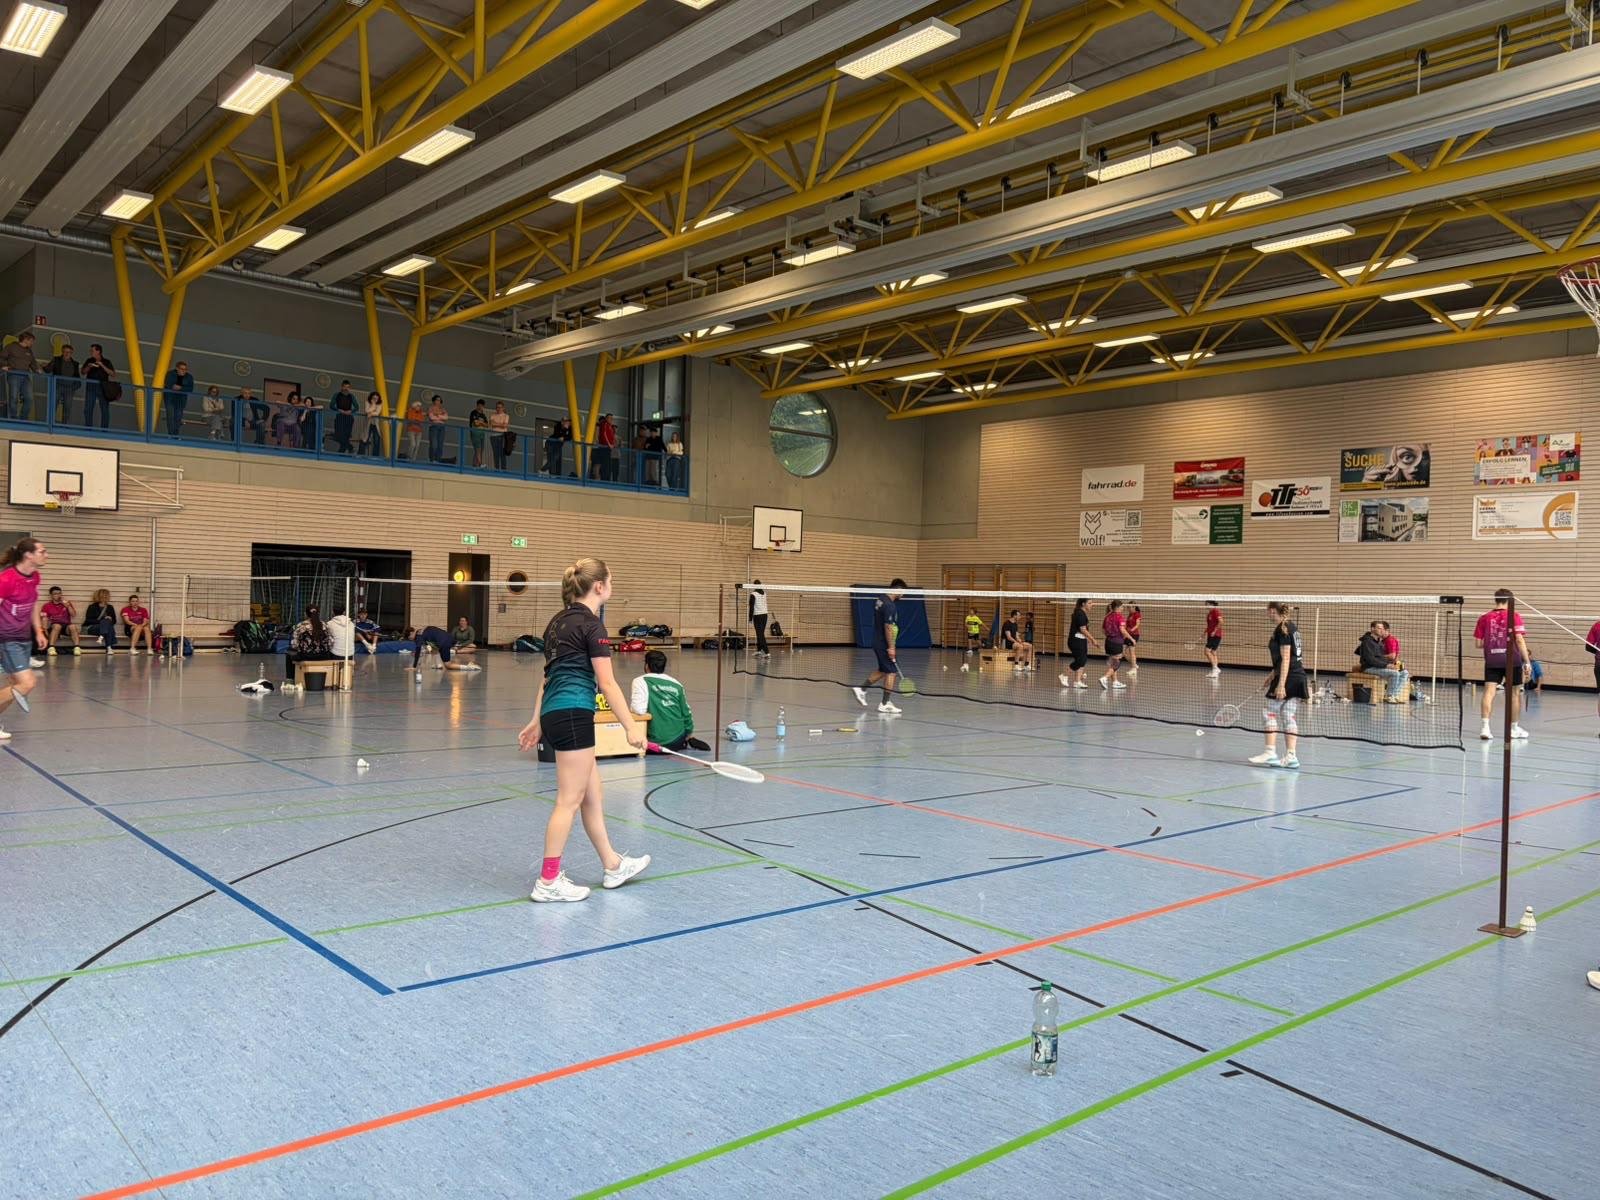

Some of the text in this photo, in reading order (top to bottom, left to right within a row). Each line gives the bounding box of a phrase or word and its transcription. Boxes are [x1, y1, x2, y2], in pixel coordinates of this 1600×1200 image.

[1344, 453, 1384, 468] SUCHE
[1088, 480, 1137, 490] fahrrad.de
[1270, 483, 1298, 506] TTF
[1081, 534, 1105, 546] wolf!
